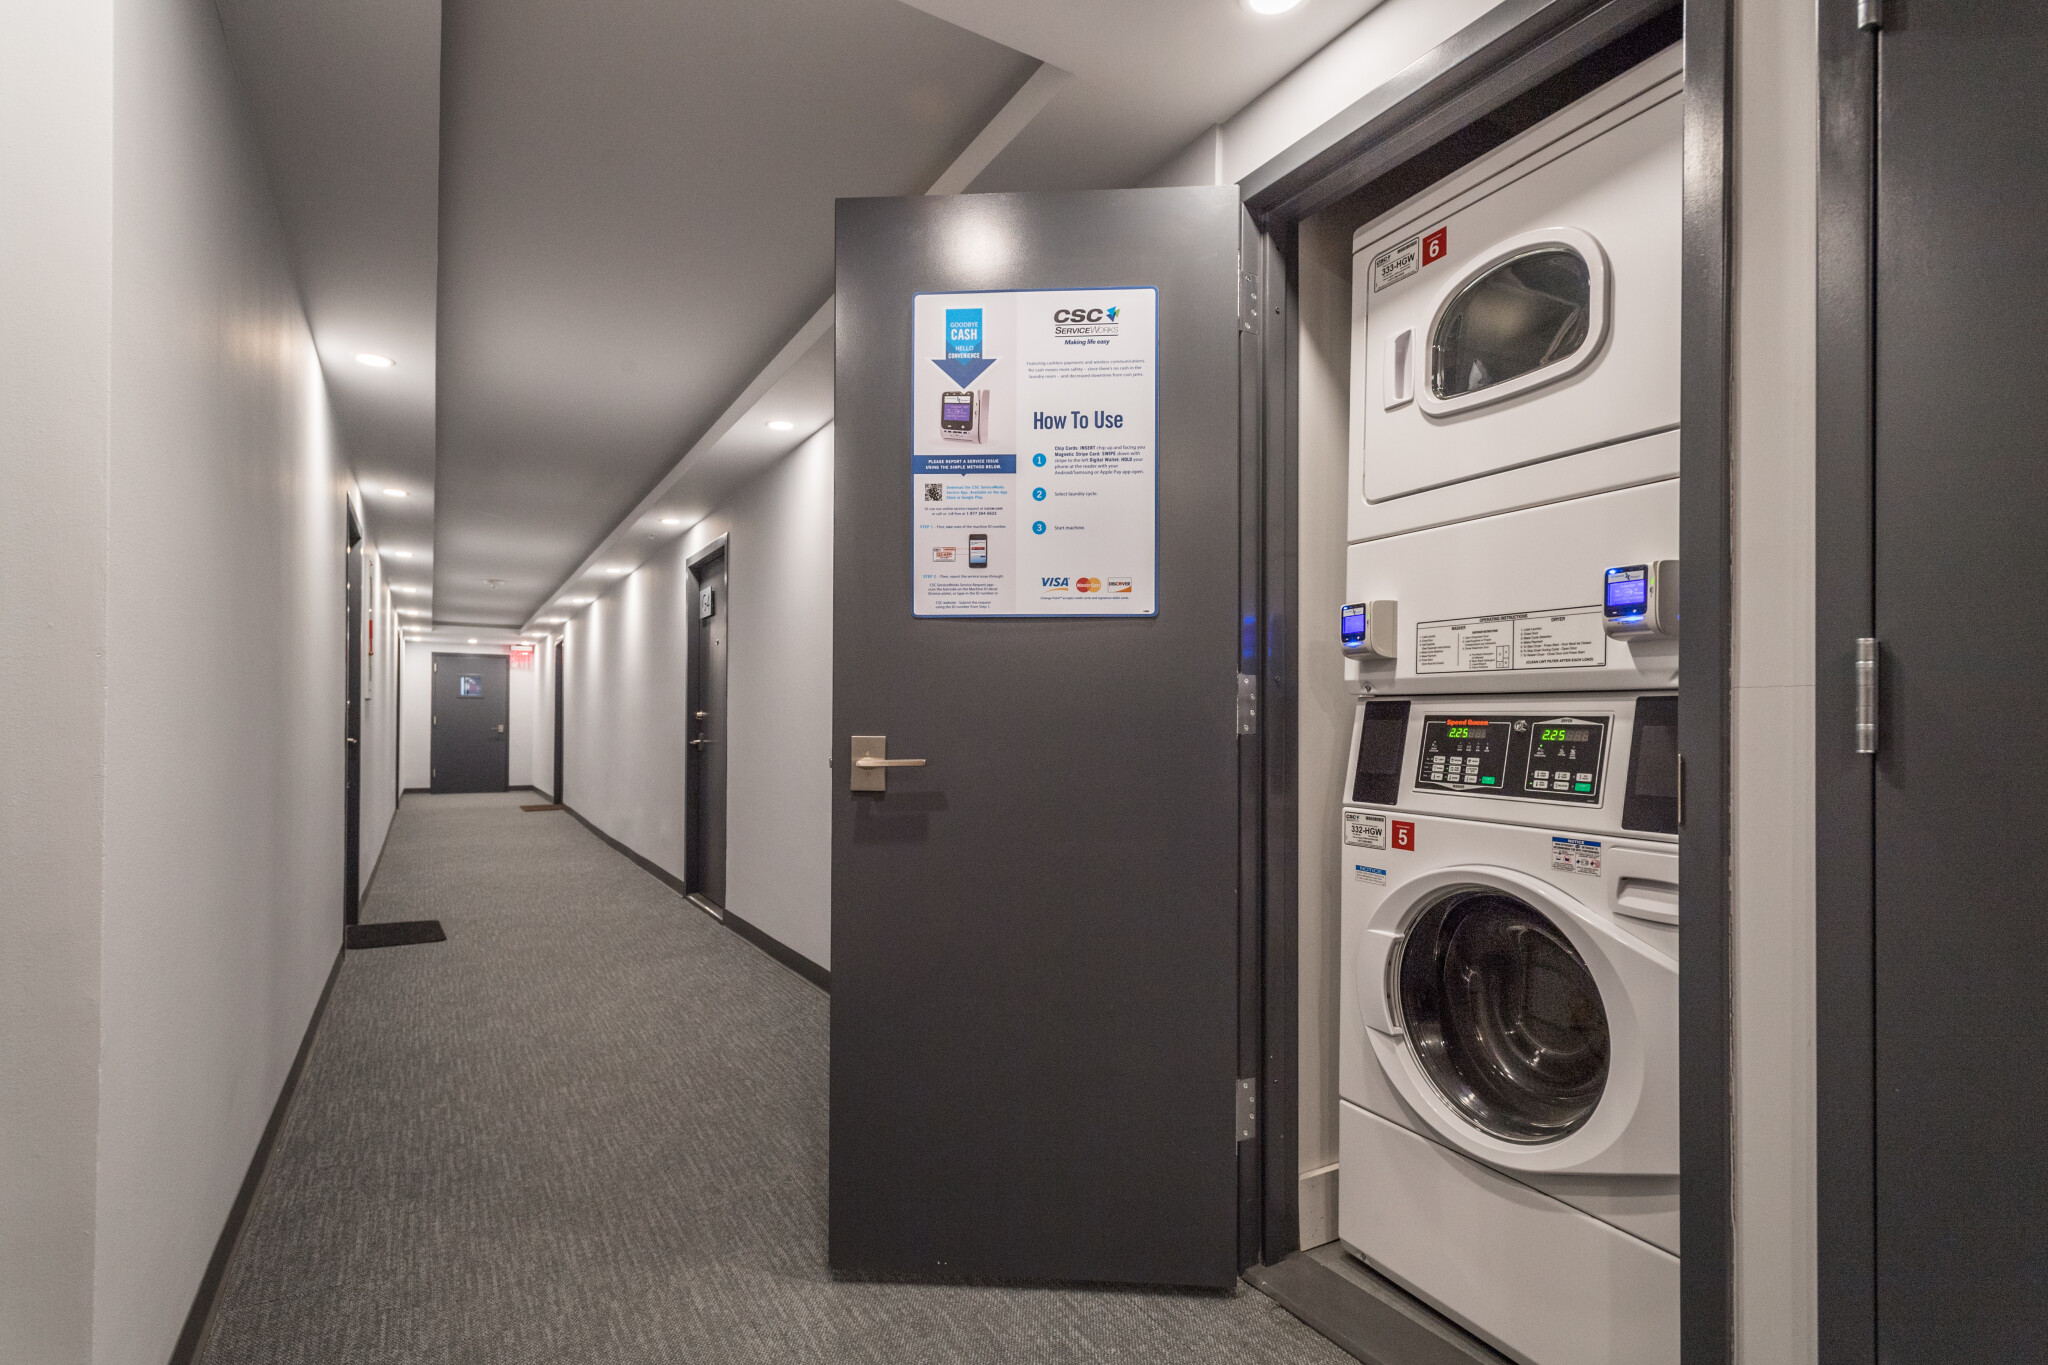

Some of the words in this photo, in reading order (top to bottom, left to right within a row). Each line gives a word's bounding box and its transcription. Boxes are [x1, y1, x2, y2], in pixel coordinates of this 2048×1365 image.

[1429, 239, 1439, 258] 6
[1381, 253, 1415, 276] 333-HGW
[1054, 308, 1103, 323] CSC
[951, 328, 977, 340] CASH
[1034, 412, 1067, 429] How
[1071, 411, 1088, 429] To
[1094, 411, 1123, 429] Use
[1037, 524, 1042, 532] 3
[1041, 577, 1069, 587] VISA
[1446, 719, 1467, 727] Speed
[1351, 825, 1383, 836] 332-HGW
[1398, 829, 1408, 846] 5
